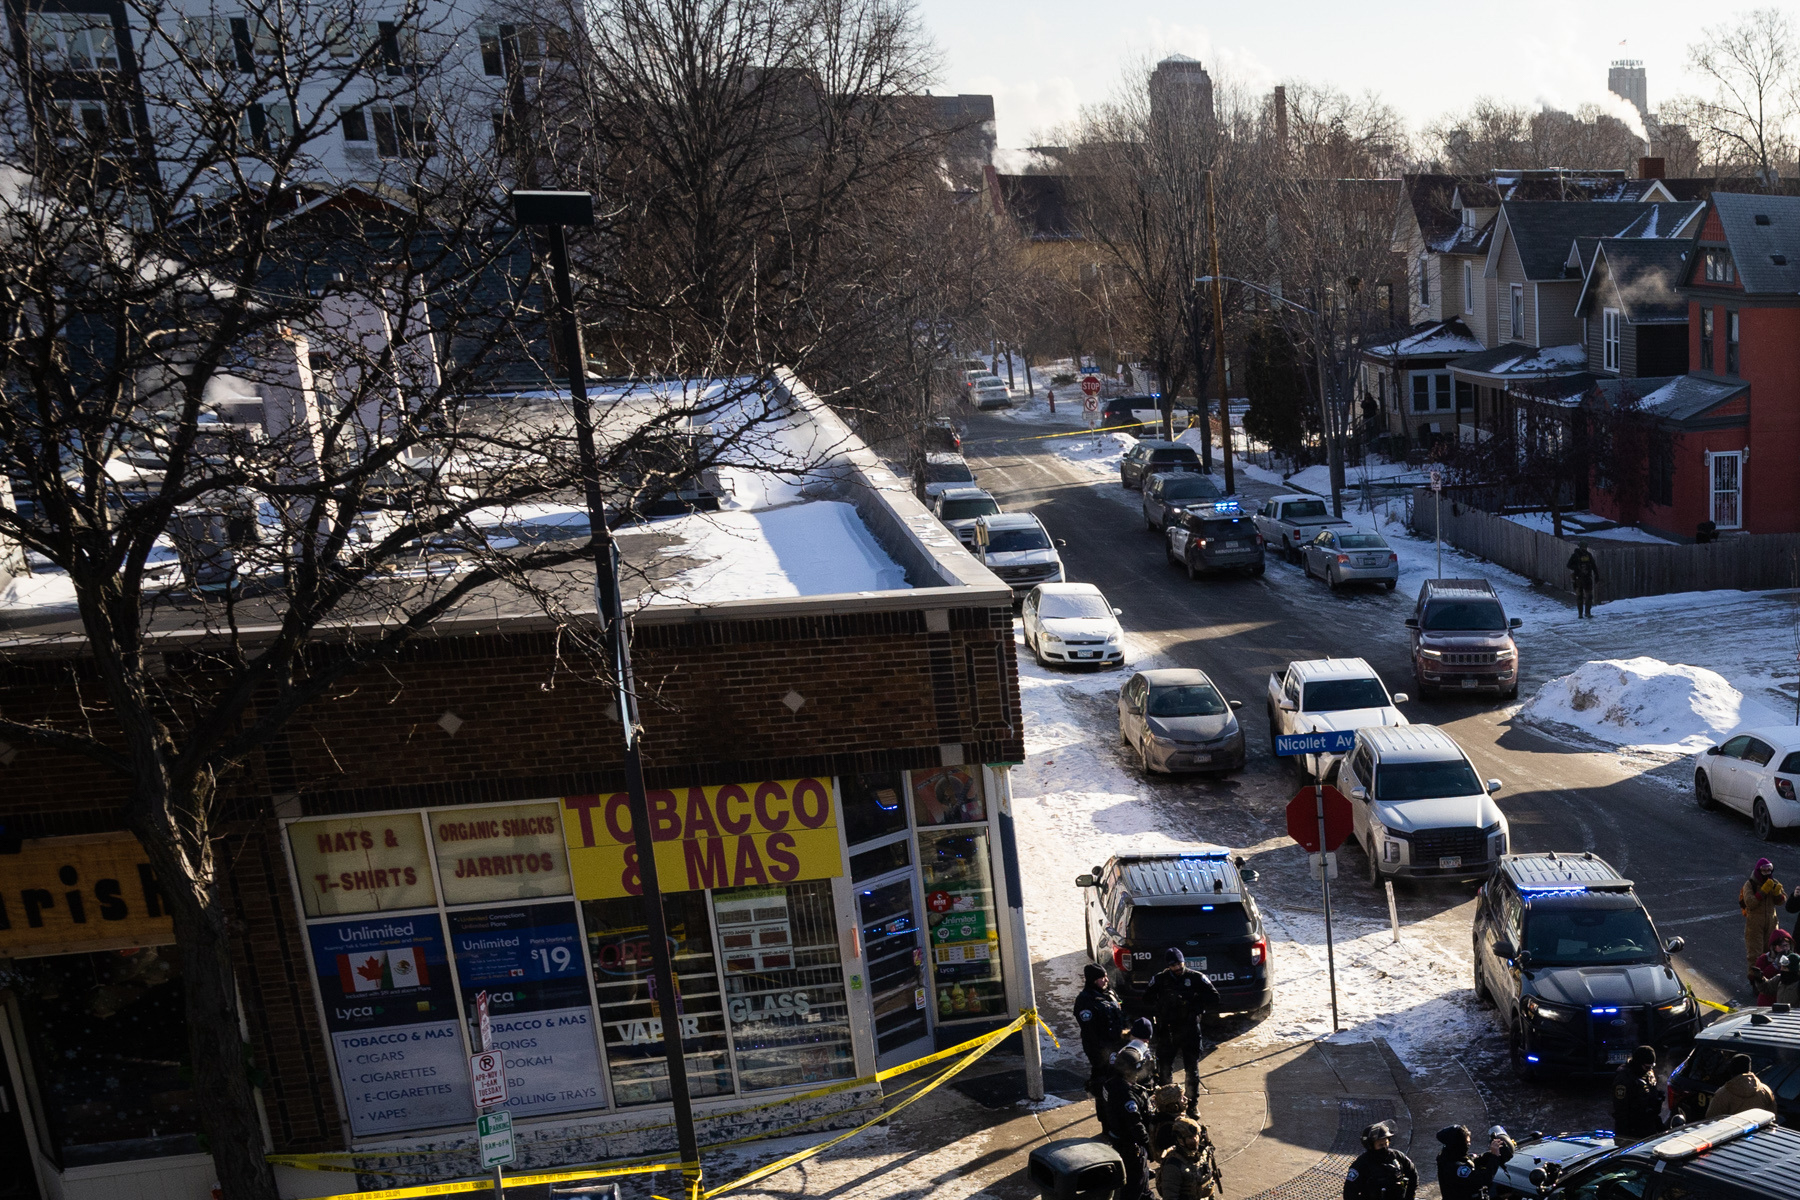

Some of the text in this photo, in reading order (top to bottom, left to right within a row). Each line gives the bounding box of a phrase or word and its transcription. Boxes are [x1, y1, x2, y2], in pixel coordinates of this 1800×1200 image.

[1082, 382, 1100, 390] STOP
[1278, 734, 1352, 751] Nicollet Av
[565, 778, 830, 849] TOBACCO
[439, 816, 555, 842] ORGANIC SNACKS
[317, 828, 399, 853] HATS &
[455, 852, 553, 878] JARRITOS
[684, 833, 800, 889] MAS
[316, 867, 417, 894] T-SHIRTS
[338, 922, 414, 942] Unlimited
[462, 936, 520, 951] Unlimited
[530, 946, 571, 973] $19
[599, 942, 654, 969] OPE
[1133, 952, 1152, 960] 120
[335, 1006, 374, 1020] Lyca
[728, 993, 811, 1023] GLASS
[490, 1015, 586, 1034] OBACCO & MAS
[342, 1028, 454, 1049] TOBACCO & MAS
[492, 1038, 537, 1051] BONGS
[356, 1050, 405, 1064] CIGARS
[505, 1056, 553, 1069] OOKAH
[360, 1066, 436, 1084] CIGARETTES
[475, 1072, 498, 1082] APR-NOV
[508, 1077, 525, 1088] BD
[479, 1085, 502, 1097] TUESDAY
[481, 1080, 498, 1088] 1-6AM
[364, 1084, 452, 1103] E-CIGARETTES
[559, 1087, 596, 1101] TRAYS
[368, 1108, 407, 1121] VAPES
[481, 1120, 486, 1133] 1
[489, 1122, 510, 1132] PARKING
